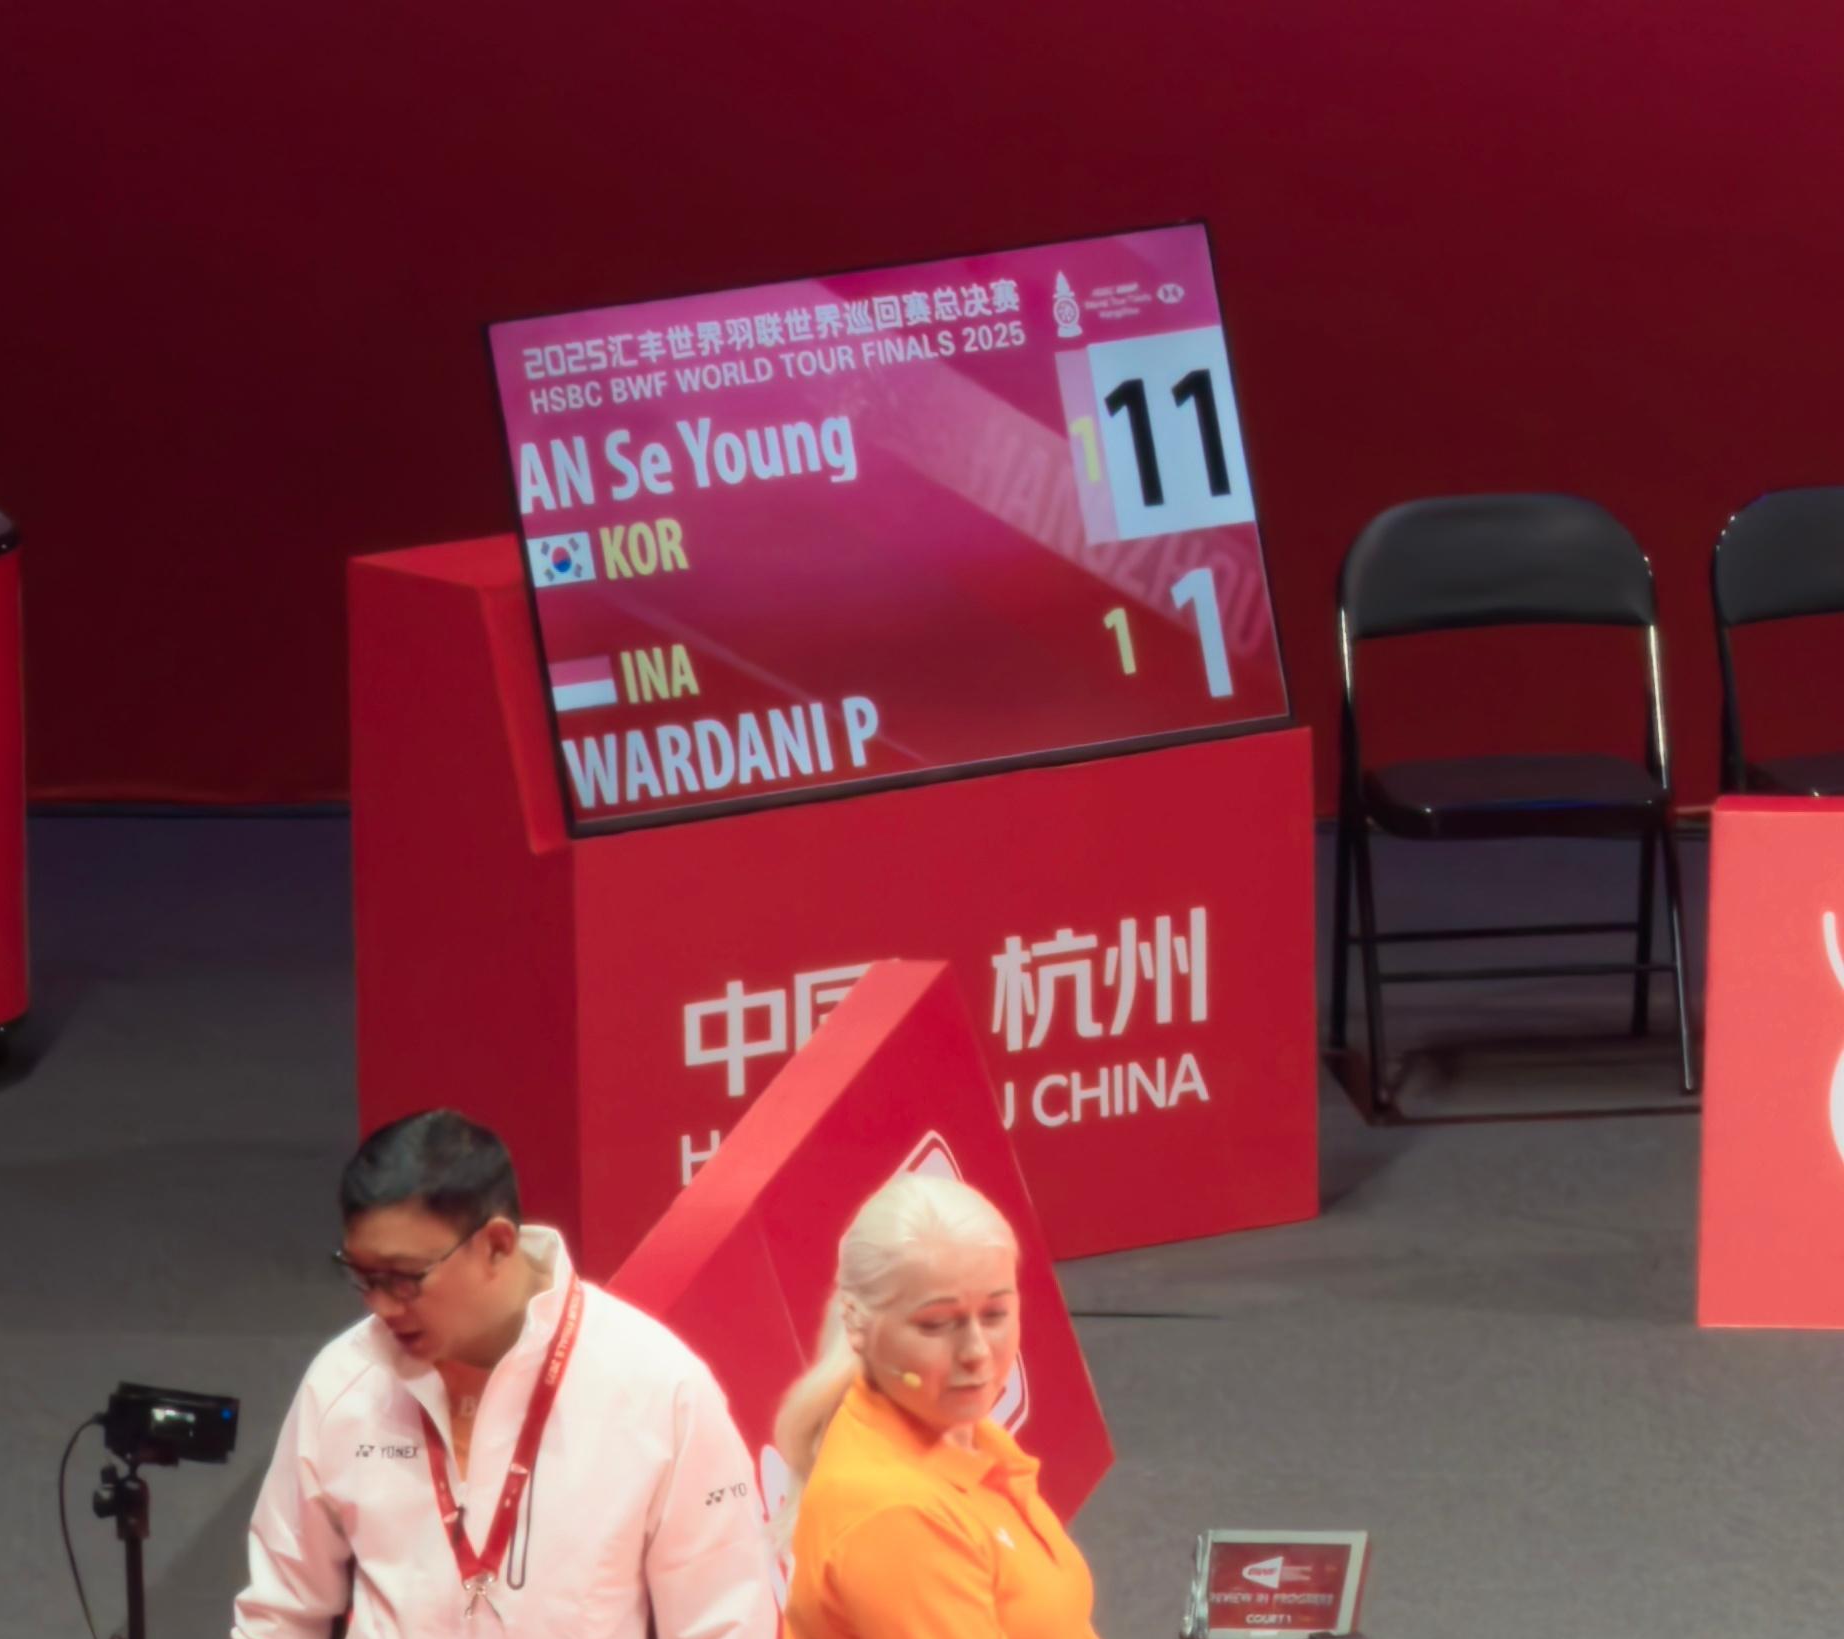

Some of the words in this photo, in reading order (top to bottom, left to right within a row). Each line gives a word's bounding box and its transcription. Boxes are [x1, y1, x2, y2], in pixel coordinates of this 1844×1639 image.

[523, 279, 1020, 380] 2025汇丰世界羽联世界巡回赛总决赛
[530, 379, 603, 415] HSBC
[609, 371, 668, 403] BWF
[674, 354, 774, 392] WORLD
[779, 344, 855, 377] TOUR
[861, 330, 956, 367] FINALS
[962, 320, 1027, 354] 2025
[519, 437, 595, 515] AN
[608, 428, 676, 501] Se
[676, 414, 858, 489] Young
[1069, 415, 1102, 483] 1
[1103, 368, 1232, 508] 11
[599, 517, 689, 580] KOR
[619, 643, 700, 704] INA
[1103, 607, 1138, 676] 1
[1170, 566, 1234, 699] 1
[561, 702, 833, 808] WARDANI
[842, 696, 879, 768] P
[991, 907, 1208, 1053] 杭州
[1032, 1052, 1210, 1128] CHINA
